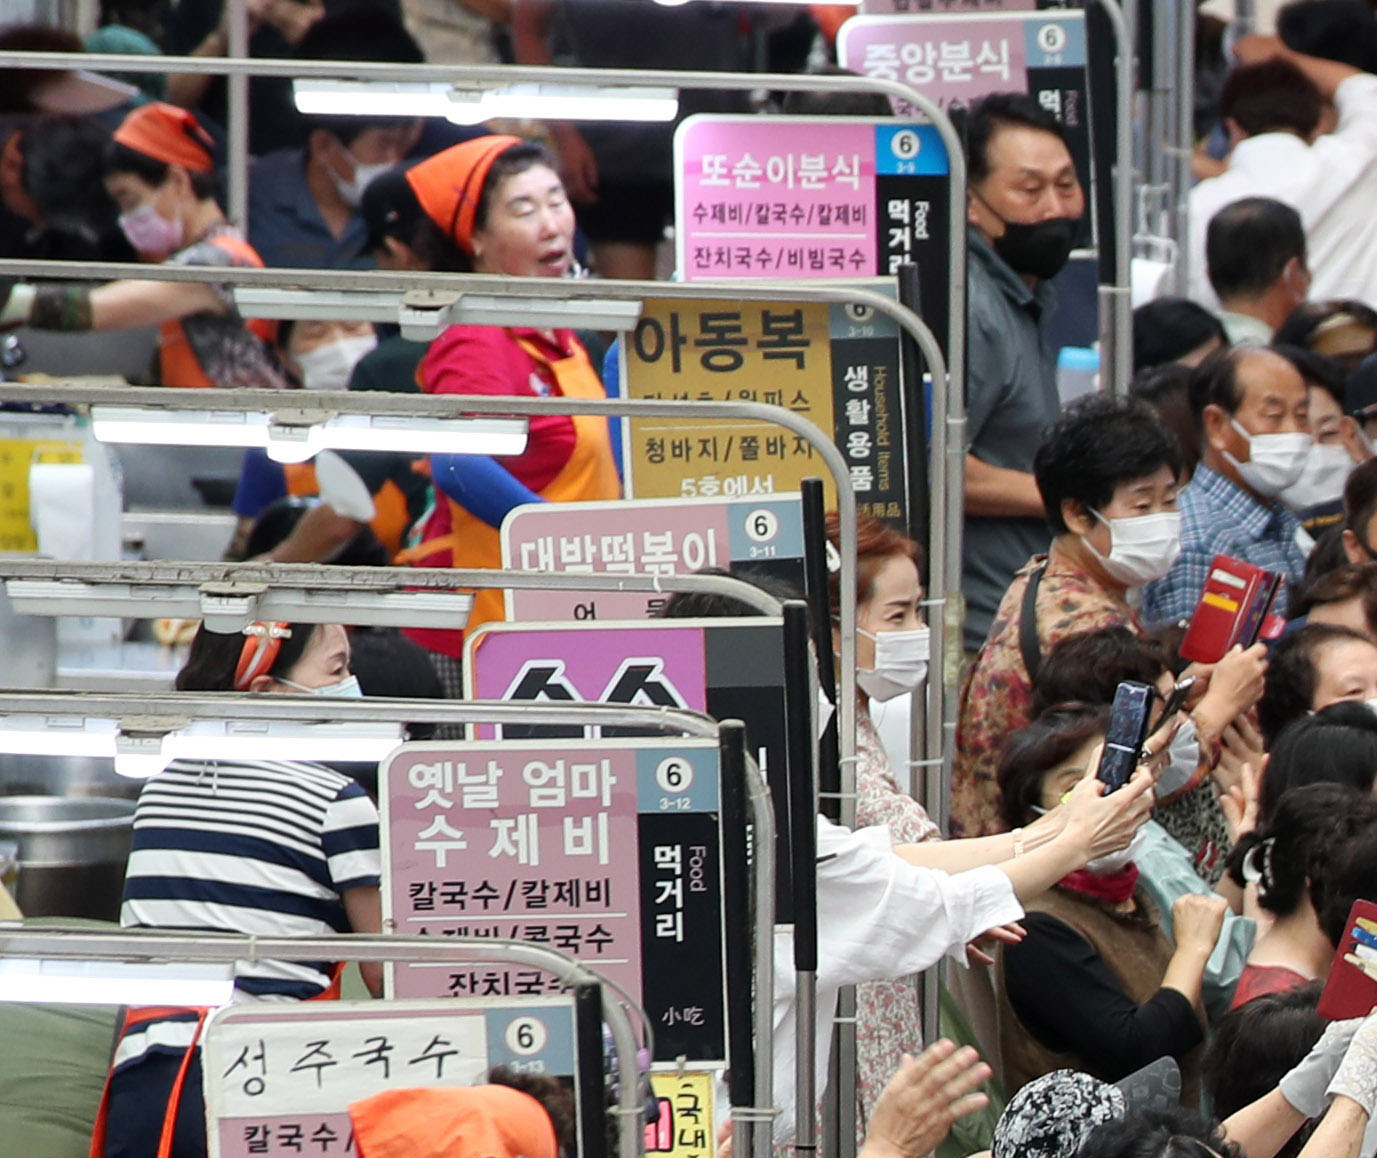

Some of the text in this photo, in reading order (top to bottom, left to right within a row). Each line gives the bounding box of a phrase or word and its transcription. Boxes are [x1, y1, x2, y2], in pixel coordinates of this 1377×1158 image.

[1045, 28, 1057, 47] 6
[863, 39, 1010, 84] 중앙분식
[899, 134, 912, 153] 6
[699, 153, 861, 190] 또순이분식
[692, 203, 867, 226] 수제비/칼국수/칼제비
[914, 200, 930, 240] Food
[693, 246, 867, 271] 잔치국수/비빔국수
[633, 309, 811, 373] 아동복
[844, 365, 874, 492] 생활용품
[873, 365, 891, 491] Household Items
[680, 474, 775, 498] 5호에서
[753, 515, 769, 536] 6
[519, 529, 717, 576] 대박떡볶이
[748, 545, 777, 558] 3-11
[407, 758, 618, 810] 옛날 엄마
[666, 763, 682, 787] 6
[658, 797, 692, 810] 3-12
[688, 845, 707, 892] Food
[408, 879, 611, 911] 칼국수/칼제비
[654, 844, 684, 943] 먹거리
[661, 1006, 705, 1026] 小吃
[518, 1025, 534, 1047] 6
[224, 1034, 459, 1097] 성주국수
[244, 1123, 354, 1154] 칼국수/
